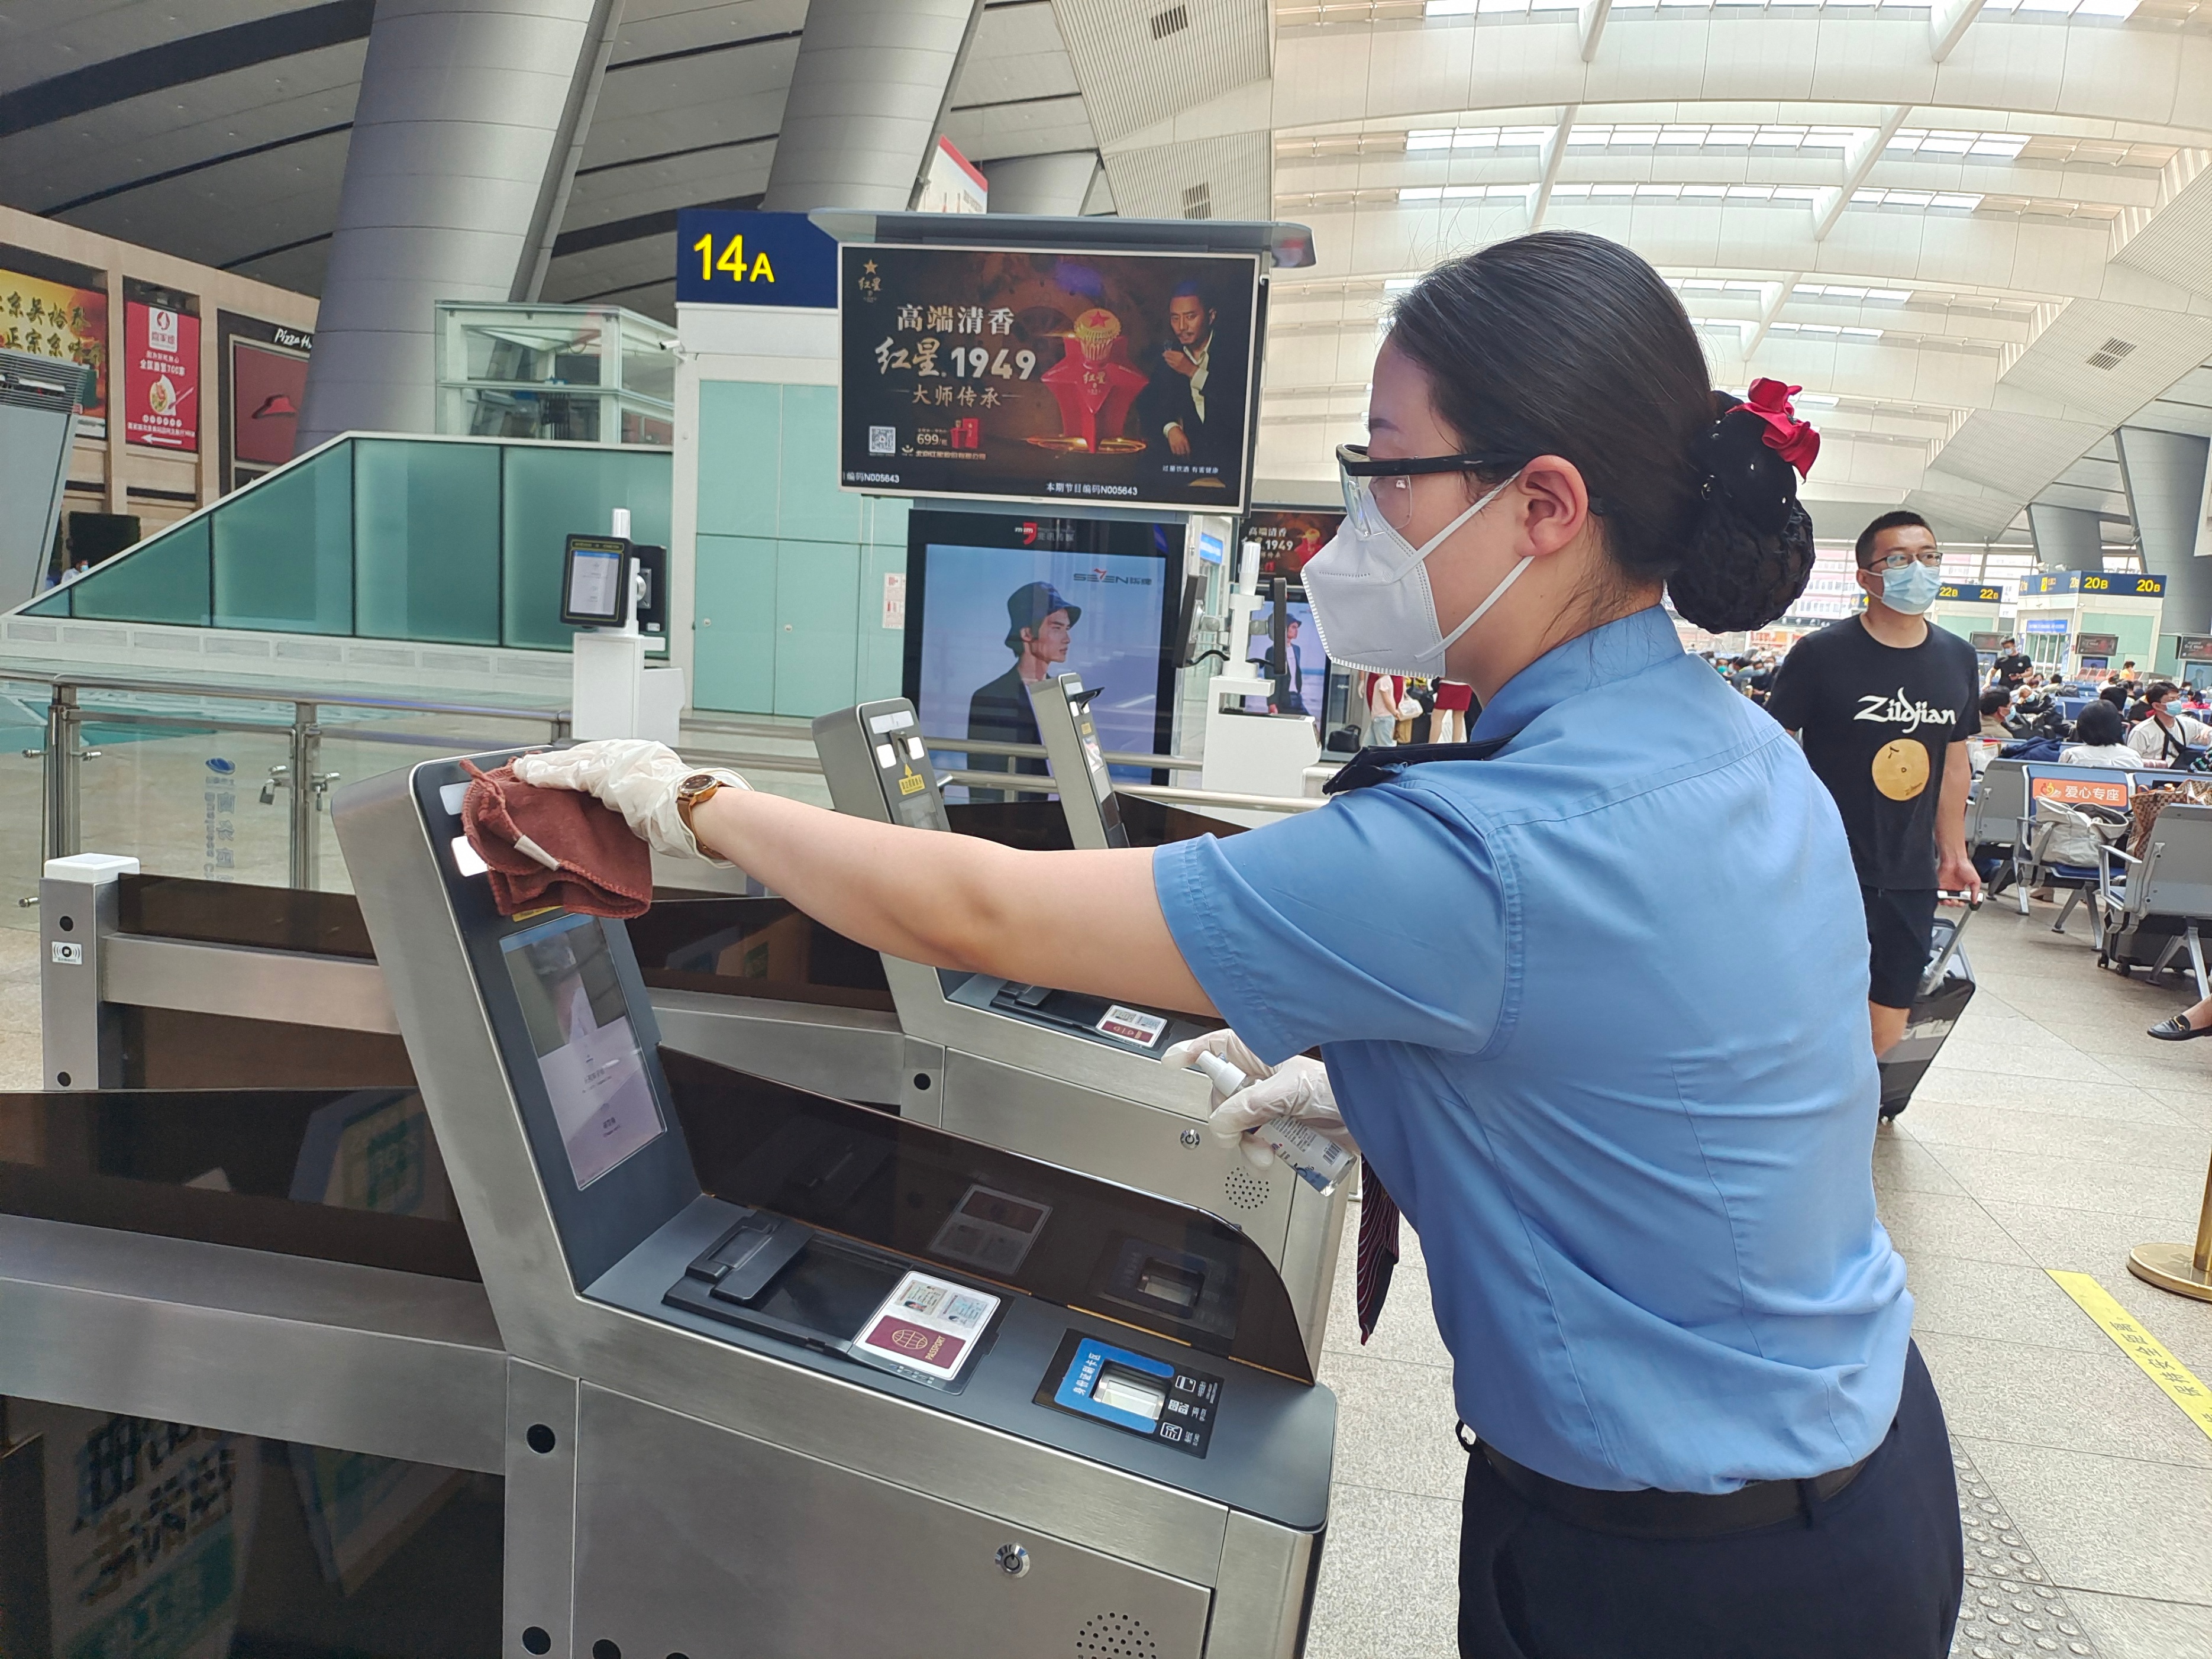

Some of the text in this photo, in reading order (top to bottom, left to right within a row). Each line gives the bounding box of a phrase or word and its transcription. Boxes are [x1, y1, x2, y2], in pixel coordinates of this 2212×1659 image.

[693, 233, 774, 282] 14A
[897, 303, 1015, 335] 高端清香
[274, 328, 300, 346] Pizza
[875, 337, 1036, 380] 红星 1949
[912, 385, 1001, 408] 大师传承
[843, 472, 900, 483] 编码N005643
[1047, 482, 1138, 495] 本期节目编码N005643
[1265, 540, 1293, 551] 1949
[1939, 586, 1958, 598] 22B
[2084, 576, 2108, 589] 20B
[1853, 686, 1957, 734] Zildjian
[2065, 785, 2120, 802] 爱心专座
[925, 1335, 946, 1361] PASSPORT
[1073, 1353, 1101, 1396] 身份证刷卡区
